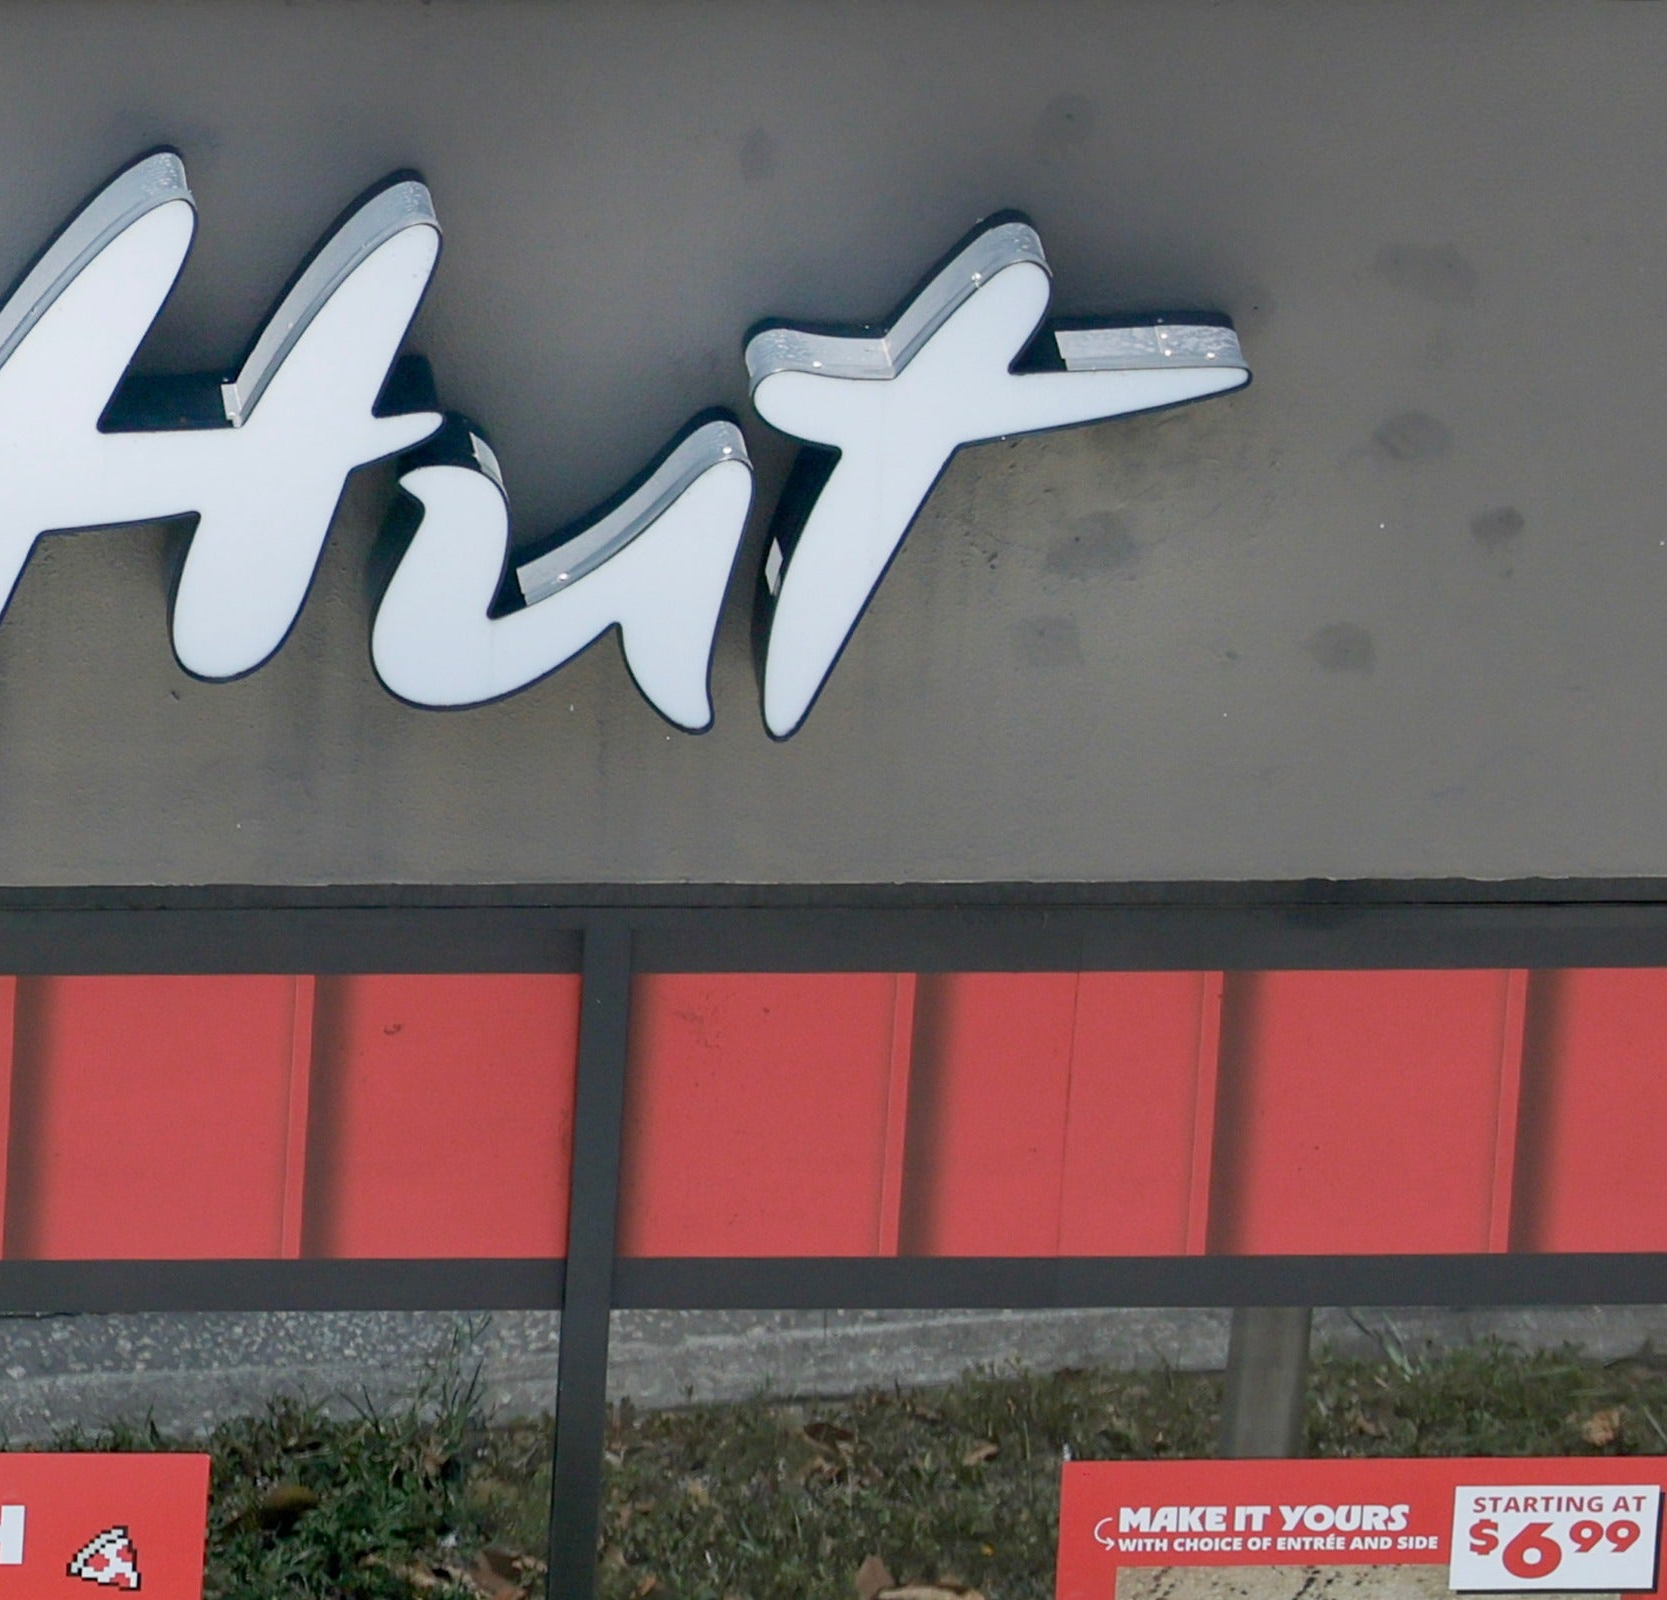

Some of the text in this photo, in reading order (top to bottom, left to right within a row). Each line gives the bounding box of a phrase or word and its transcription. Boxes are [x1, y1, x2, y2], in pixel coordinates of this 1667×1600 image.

[1472, 1496, 1647, 1513] STARTING AT
[1119, 1504, 1410, 1533] MAKE IT YOURS
[1118, 1533, 1438, 1551] WITH CHOICE OF ENTRÉE AND SIDE
